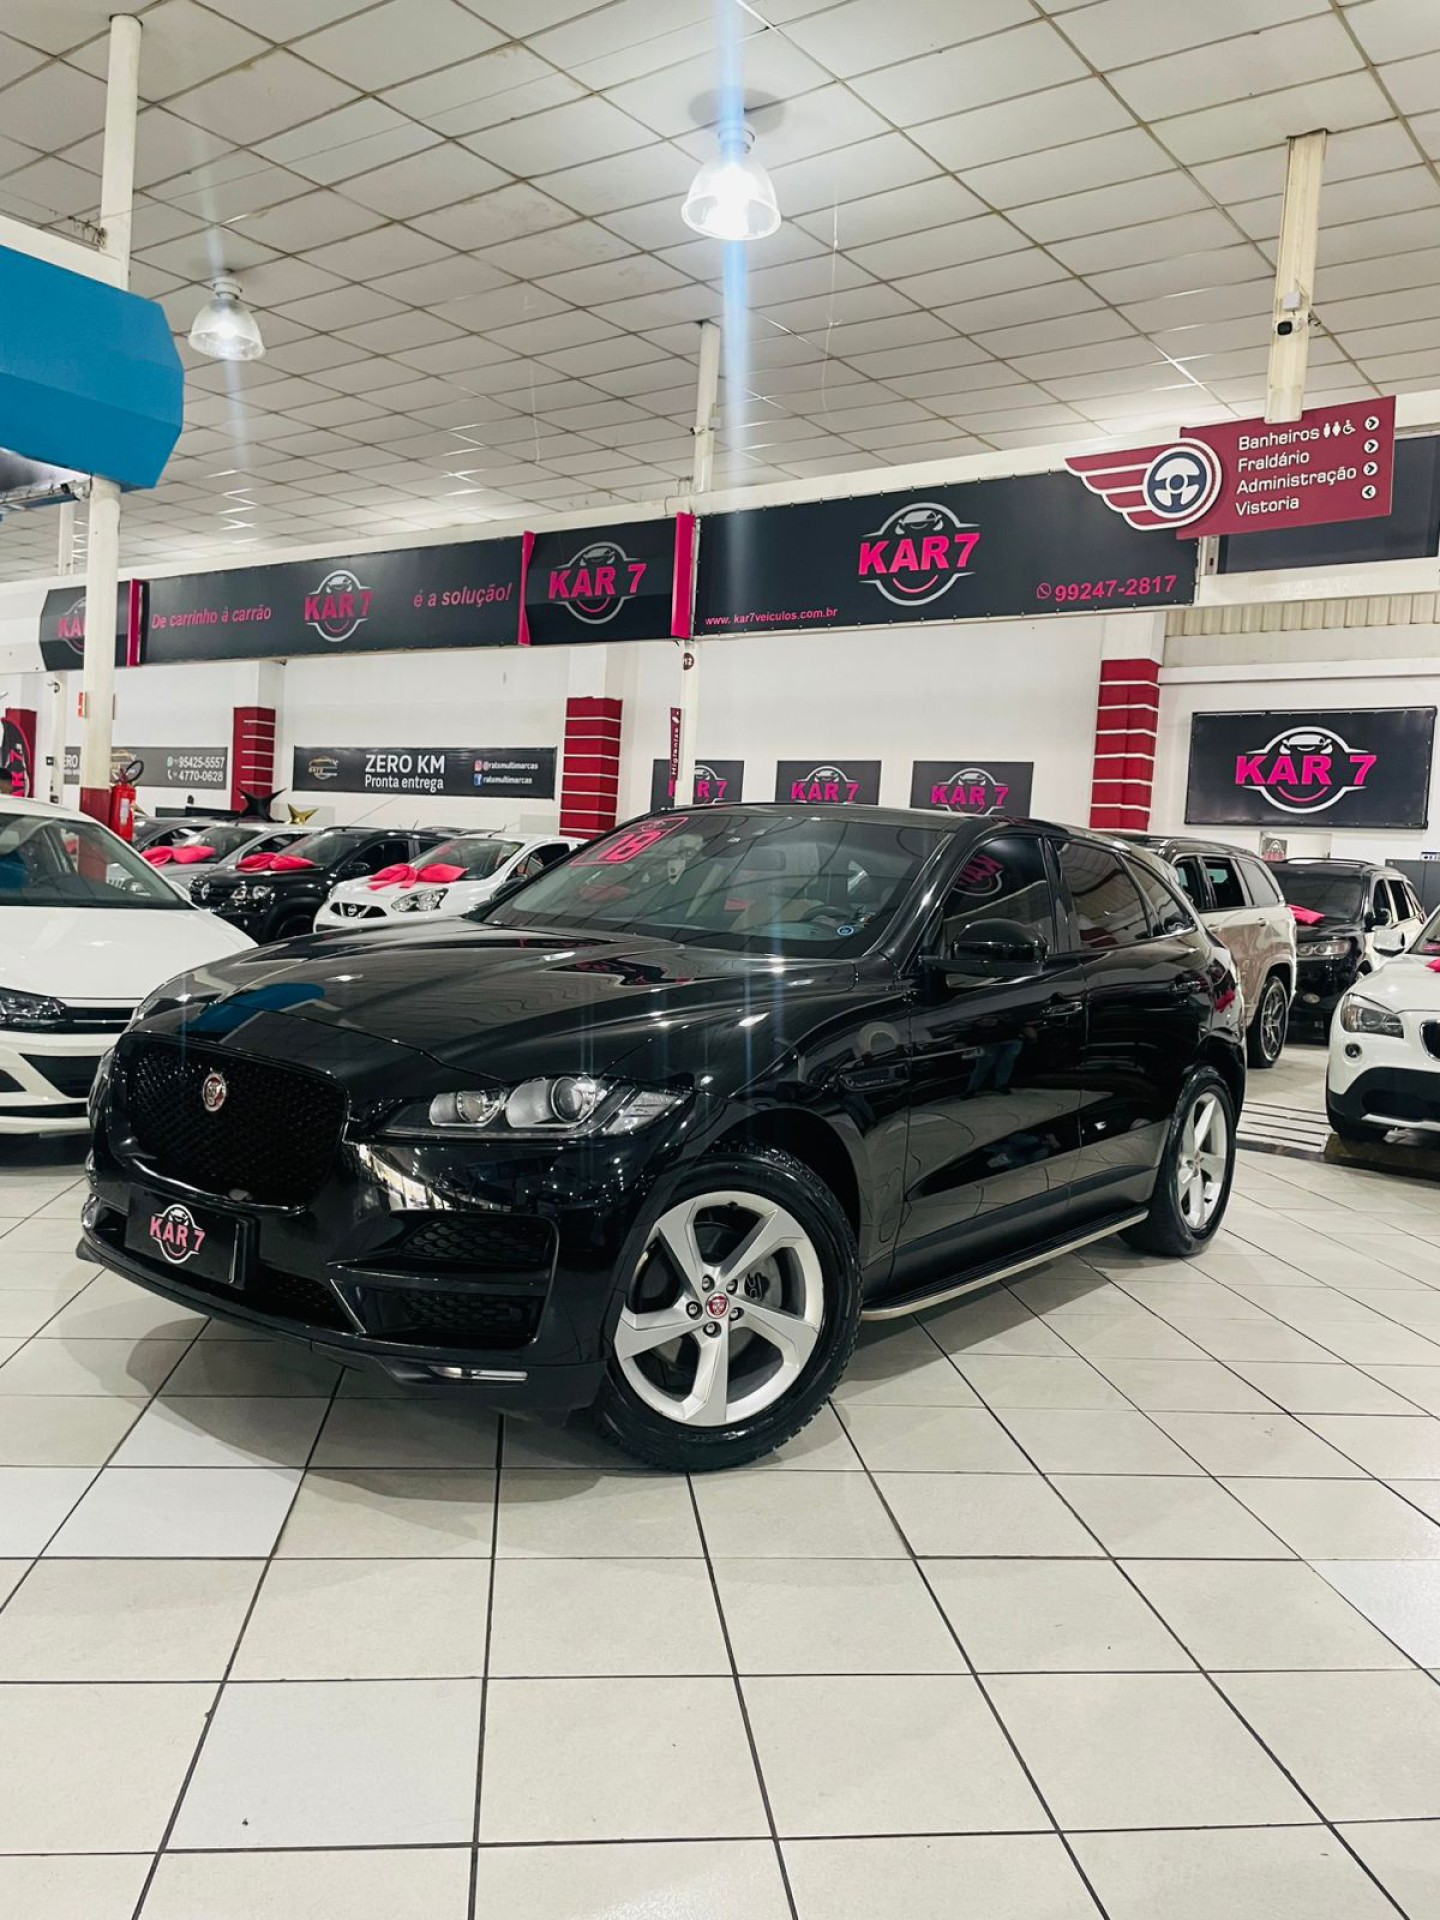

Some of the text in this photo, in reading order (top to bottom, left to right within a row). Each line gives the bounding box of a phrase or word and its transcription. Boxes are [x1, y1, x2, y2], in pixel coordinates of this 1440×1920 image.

[1238, 428, 1320, 450] Banheiros
[1238, 450, 1310, 472] Fraldário
[1236, 467, 1357, 494] Administração
[1235, 496, 1299, 516] Vistoria
[548, 562, 648, 600] KAR 7
[1054, 574, 1177, 602] 99247-2817
[304, 590, 374, 621] KAR 7
[413, 582, 513, 608] é a solução!
[56, 616, 85, 639] KA
[151, 614, 167, 629] De
[169, 607, 218, 627] carrinho
[232, 604, 272, 622] carrão
[364, 754, 446, 774] ZERO KM
[1235, 754, 1377, 786] KAR 7
[364, 773, 444, 793] Pronta entrega
[717, 780, 728, 798] 7
[791, 782, 861, 803] KAR 7
[931, 785, 1009, 806] KAR 7
[150, 1216, 206, 1251] KAR 7
